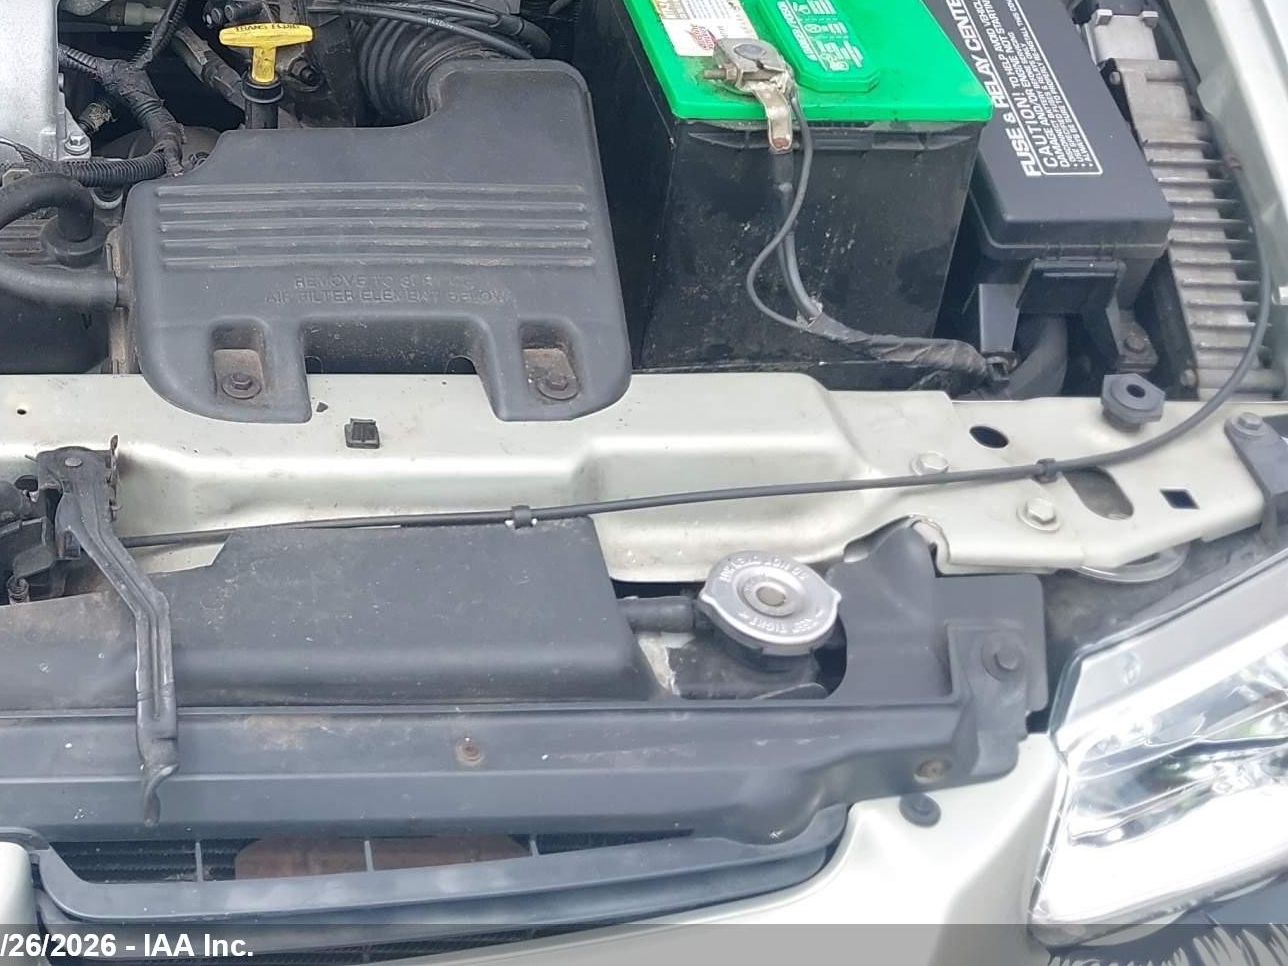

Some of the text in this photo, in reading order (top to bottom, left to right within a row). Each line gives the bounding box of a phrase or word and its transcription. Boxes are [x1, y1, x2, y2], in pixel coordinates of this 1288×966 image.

[984, 28, 1003, 51] AVOID
[998, 35, 1014, 52] NOT
[1007, 31, 1028, 64] SERVICING
[1019, 27, 1042, 60] RE-INSTALL
[1019, 42, 1033, 58] ONLY
[997, 53, 1014, 74] HELP
[1008, 55, 1031, 86] ENGINE
[1024, 66, 1040, 88] BEFORE
[1028, 60, 1045, 83] RELAYS
[971, 54, 1010, 108] RELAY
[1007, 75, 1021, 88] TO
[1037, 62, 1059, 94] PROPERLY
[1024, 88, 1050, 125] AND/OR
[1036, 90, 1054, 118] BATTERY
[1043, 91, 1059, 112] FUSES
[1000, 112, 1017, 123] &
[1011, 92, 1059, 166] CAUTION!
[1054, 114, 1076, 146] SPECIFIED
[1004, 127, 1042, 175] FUSE
[1042, 127, 1070, 166] DAMAGE
[1072, 133, 1092, 161] ALWAYS
[294, 275, 365, 289] REMOVE
[372, 275, 394, 289] TO
[265, 289, 506, 305] AIR FILTER ELEMENT BELOW
